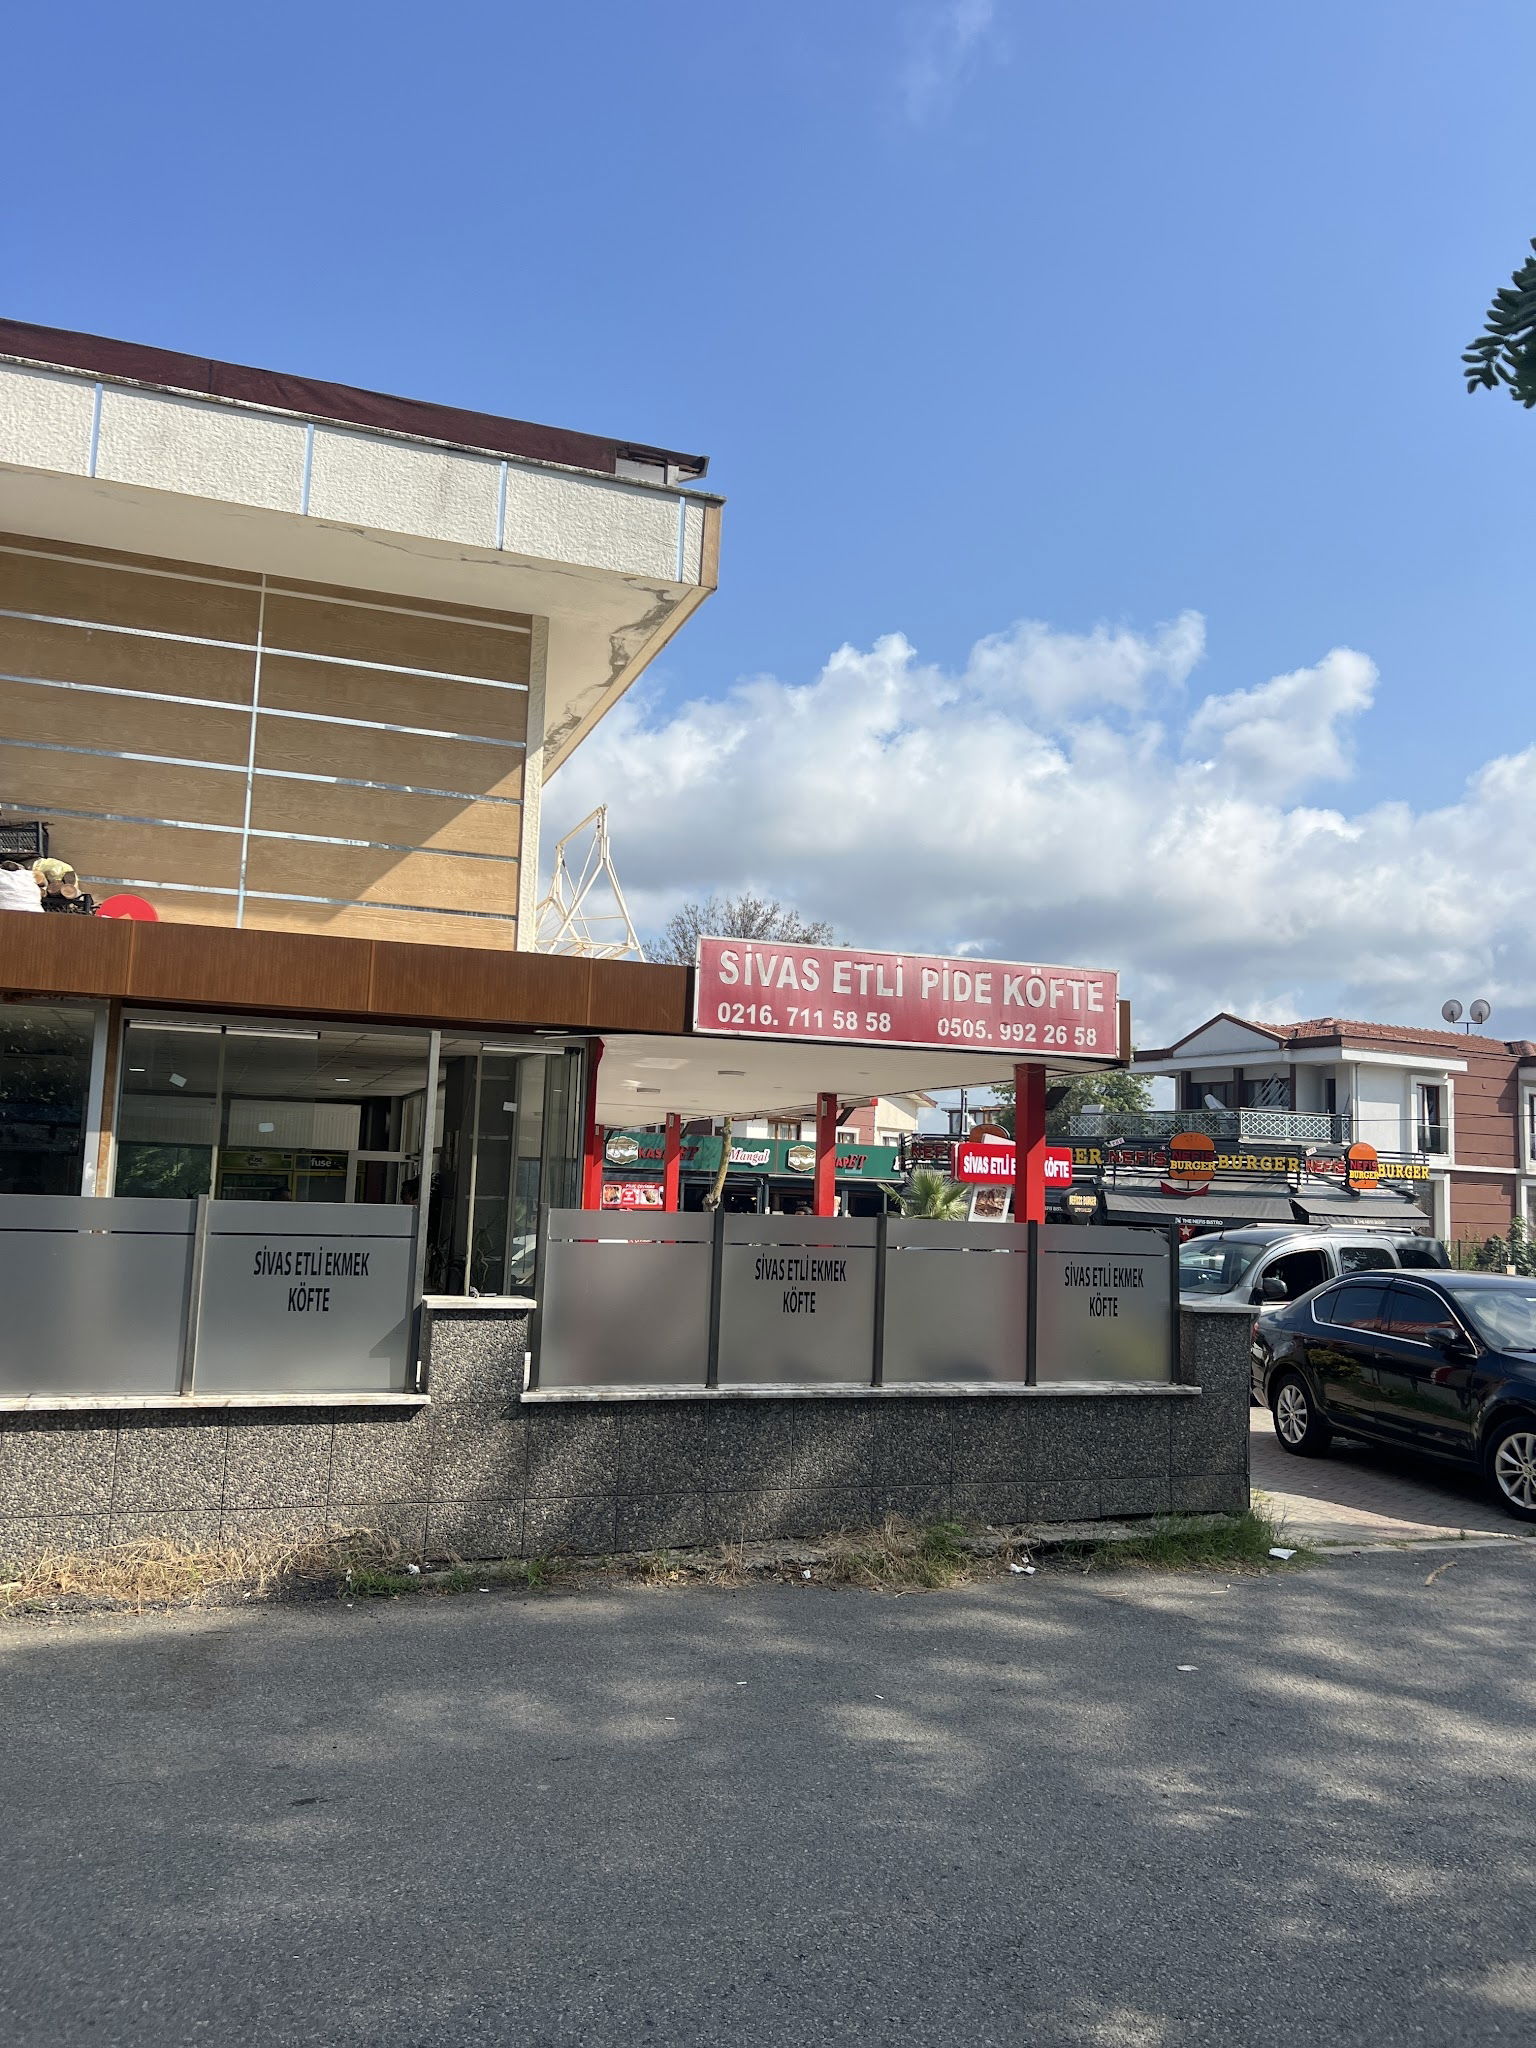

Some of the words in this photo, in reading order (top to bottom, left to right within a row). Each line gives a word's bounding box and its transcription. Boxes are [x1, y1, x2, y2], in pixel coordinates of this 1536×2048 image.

[718, 944, 820, 992] SİVAS
[832, 957, 904, 997] ETLİ
[920, 961, 993, 1005] PİDE
[1003, 967, 1105, 1012] KÖFTE
[717, 1002, 779, 1026] 0216.
[786, 1006, 824, 1028] 711
[832, 1009, 858, 1031] 58
[865, 1011, 891, 1033] 58
[937, 1017, 993, 1040] 0505.
[999, 1022, 1037, 1043] 992
[1043, 1023, 1068, 1045] 26
[1073, 1026, 1097, 1047] 58
[311, 1157, 332, 1167] fuse
[729, 1147, 769, 1165] Mangal
[963, 1152, 989, 1175] SİVAS
[990, 1153, 1010, 1176] ETLİ
[1170, 1160, 1217, 1172] BURGER
[1217, 1154, 1299, 1172] BURGER
[1349, 1170, 1380, 1179] BURGER
[1378, 1163, 1430, 1180] BURGER
[253, 1245, 292, 1276] SİVAS
[294, 1246, 323, 1276] ETLİ
[325, 1252, 370, 1276] EKMEK
[755, 1252, 785, 1281] SİVAS
[787, 1254, 809, 1281] ETLİ
[811, 1260, 847, 1282] EKMEK
[1064, 1261, 1091, 1287] SİVAS
[1092, 1262, 1111, 1288] ETLİ
[1113, 1267, 1144, 1288] EKMEK
[288, 1281, 330, 1312] KÖFTE
[782, 1286, 816, 1313] KÖFTE
[1089, 1292, 1118, 1317] KÖFTE
